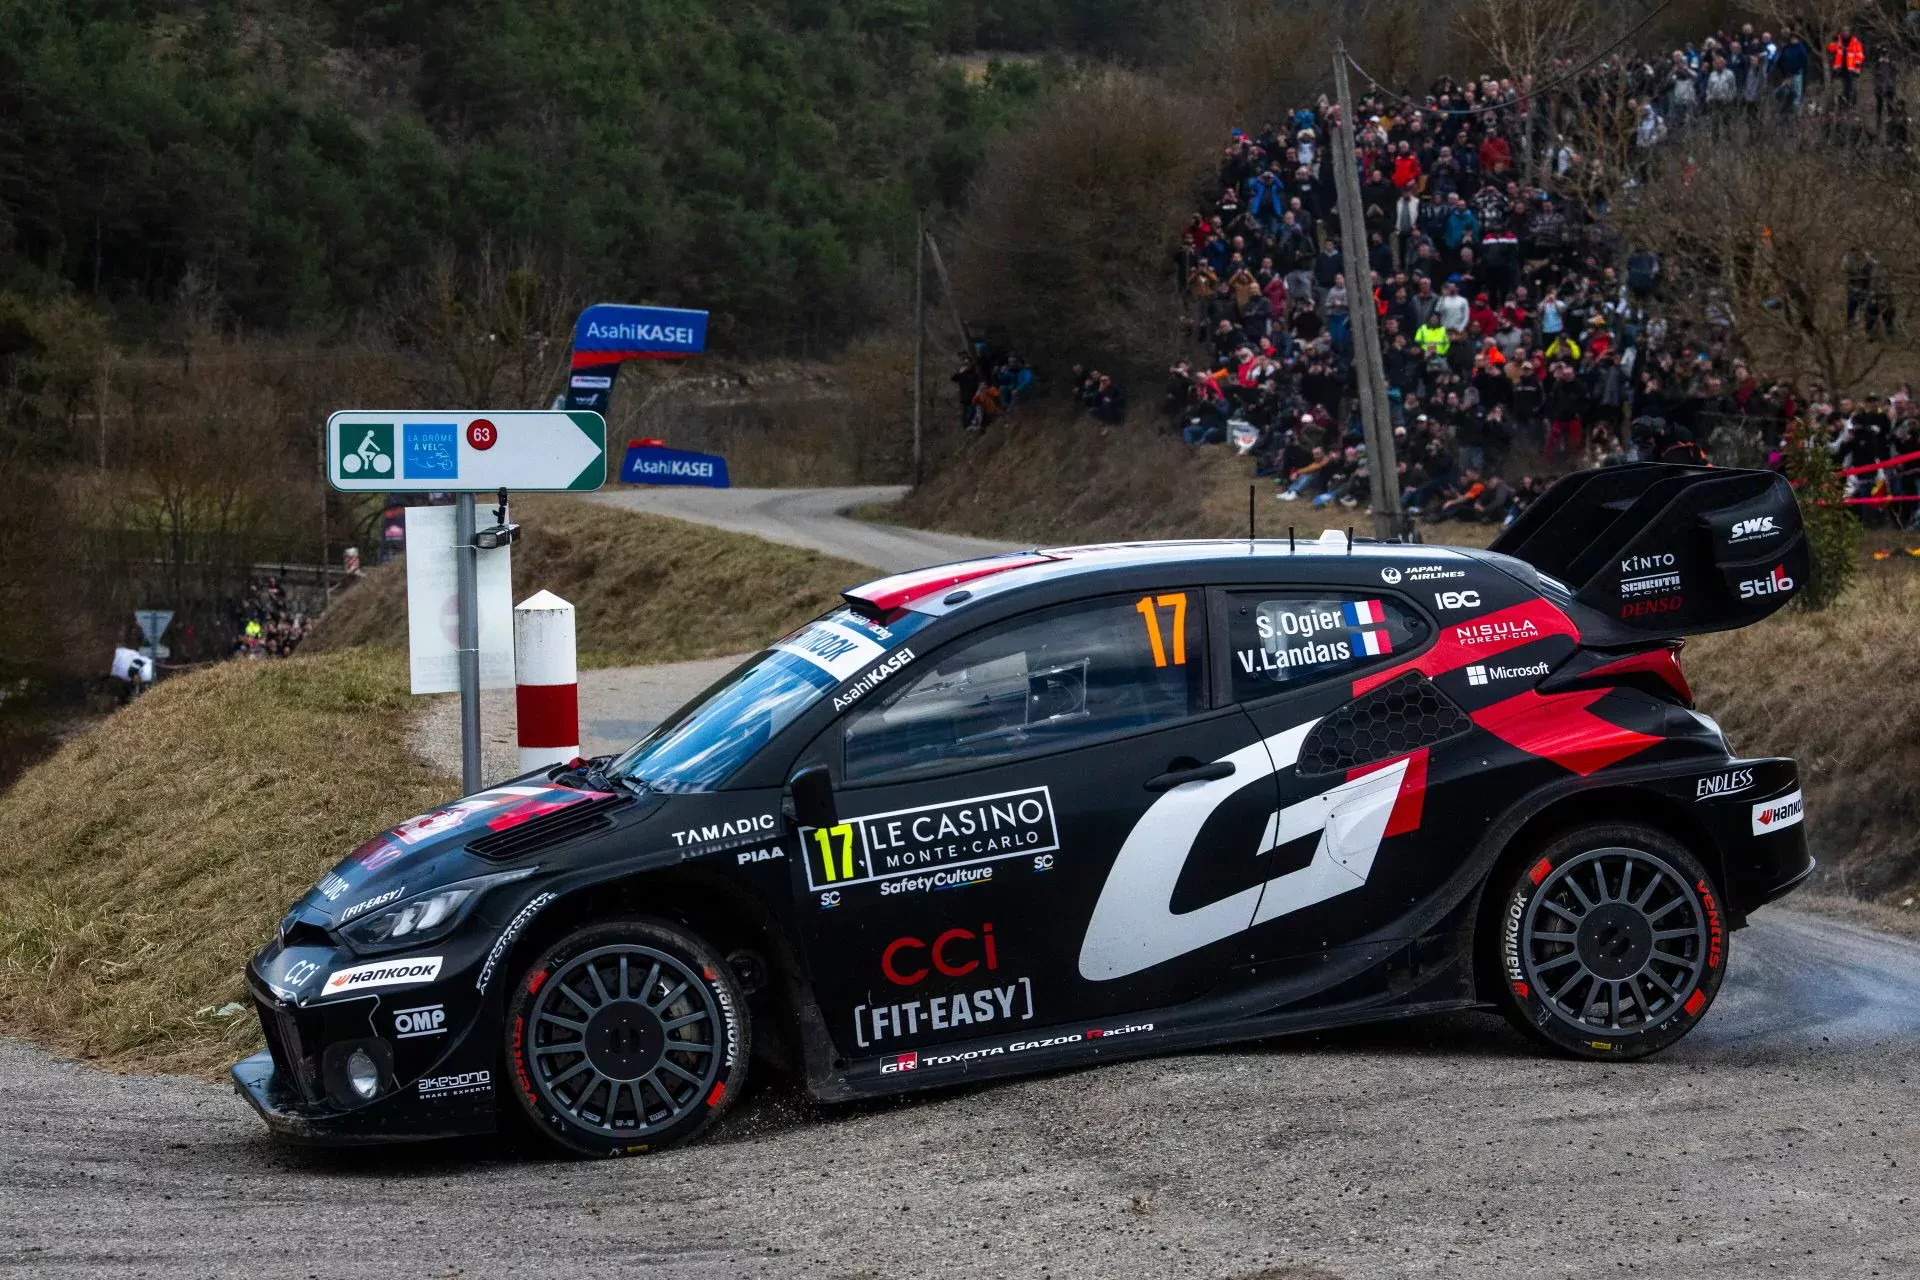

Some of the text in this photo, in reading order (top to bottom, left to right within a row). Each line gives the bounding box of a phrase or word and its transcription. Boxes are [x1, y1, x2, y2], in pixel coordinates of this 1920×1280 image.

[587, 322, 693, 344] AsahiKASEI
[473, 427, 490, 442] 63
[632, 458, 713, 477] AsahiKASEI
[1731, 516, 1774, 538] SWS
[1621, 554, 1675, 572] KINTO
[1410, 571, 1466, 580] AIRLINES
[1621, 576, 1681, 593] SCHROTH
[1739, 566, 1794, 599] Stilo
[1620, 597, 1682, 619] DENSO
[1136, 592, 1187, 667] 17
[1256, 610, 1343, 638] S.Ogier
[1457, 620, 1537, 639] NISULA
[1238, 640, 1350, 673] V.Landais
[833, 648, 915, 712] AsahiKASEI
[1489, 662, 1550, 680] Microsoft
[1696, 768, 1753, 796] ENDLESS
[672, 814, 775, 846] TAMADIC
[870, 799, 1044, 850] LE CASINO
[737, 846, 785, 865] PIAA
[814, 823, 854, 882] 17
[1034, 854, 1053, 869] SC
[880, 867, 993, 896] SafetyCulture
[820, 891, 841, 906] SC
[395, 1009, 446, 1033] OMP
[881, 1022, 1154, 1074] GR TOYOTA GAZOO Racing
[419, 1070, 490, 1090] akebono
[420, 1086, 492, 1100] BRAKE EXPERTS
